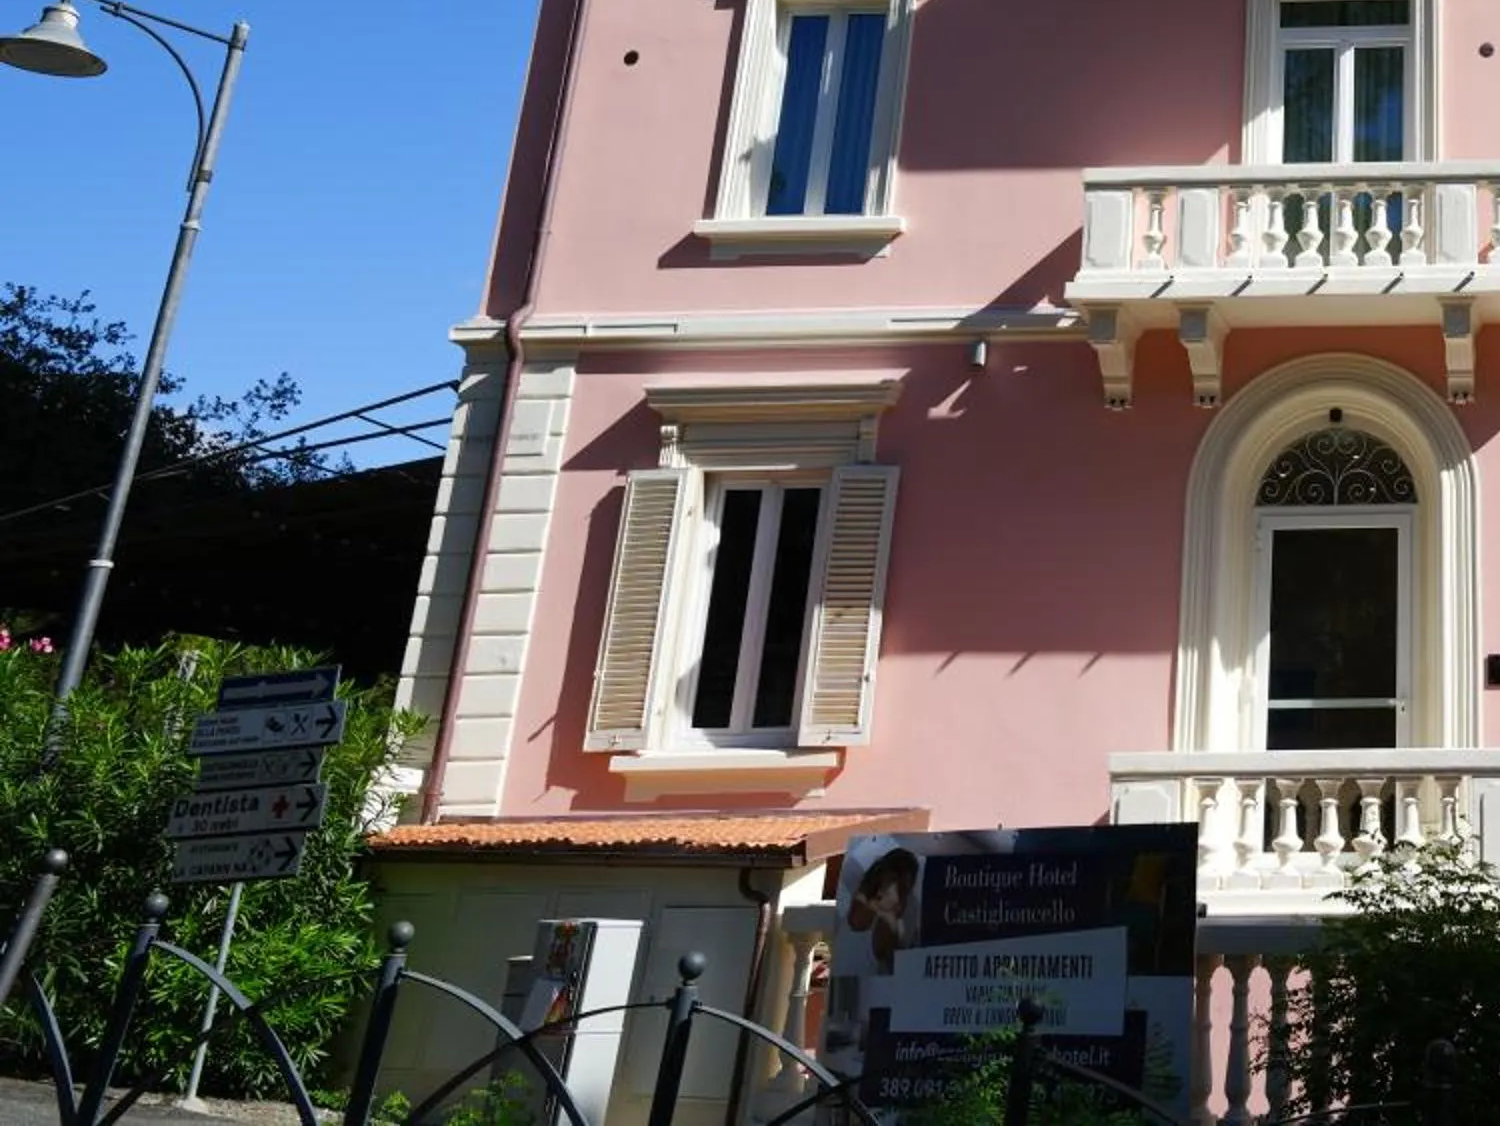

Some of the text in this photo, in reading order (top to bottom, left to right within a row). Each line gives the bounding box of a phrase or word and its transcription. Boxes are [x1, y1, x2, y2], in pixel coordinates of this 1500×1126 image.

[175, 795, 259, 818] Dentista
[944, 861, 1077, 892] Boutique Hotel
[944, 897, 1076, 930] Castiglioncello
[983, 954, 1093, 979] APPARTAMENTI
